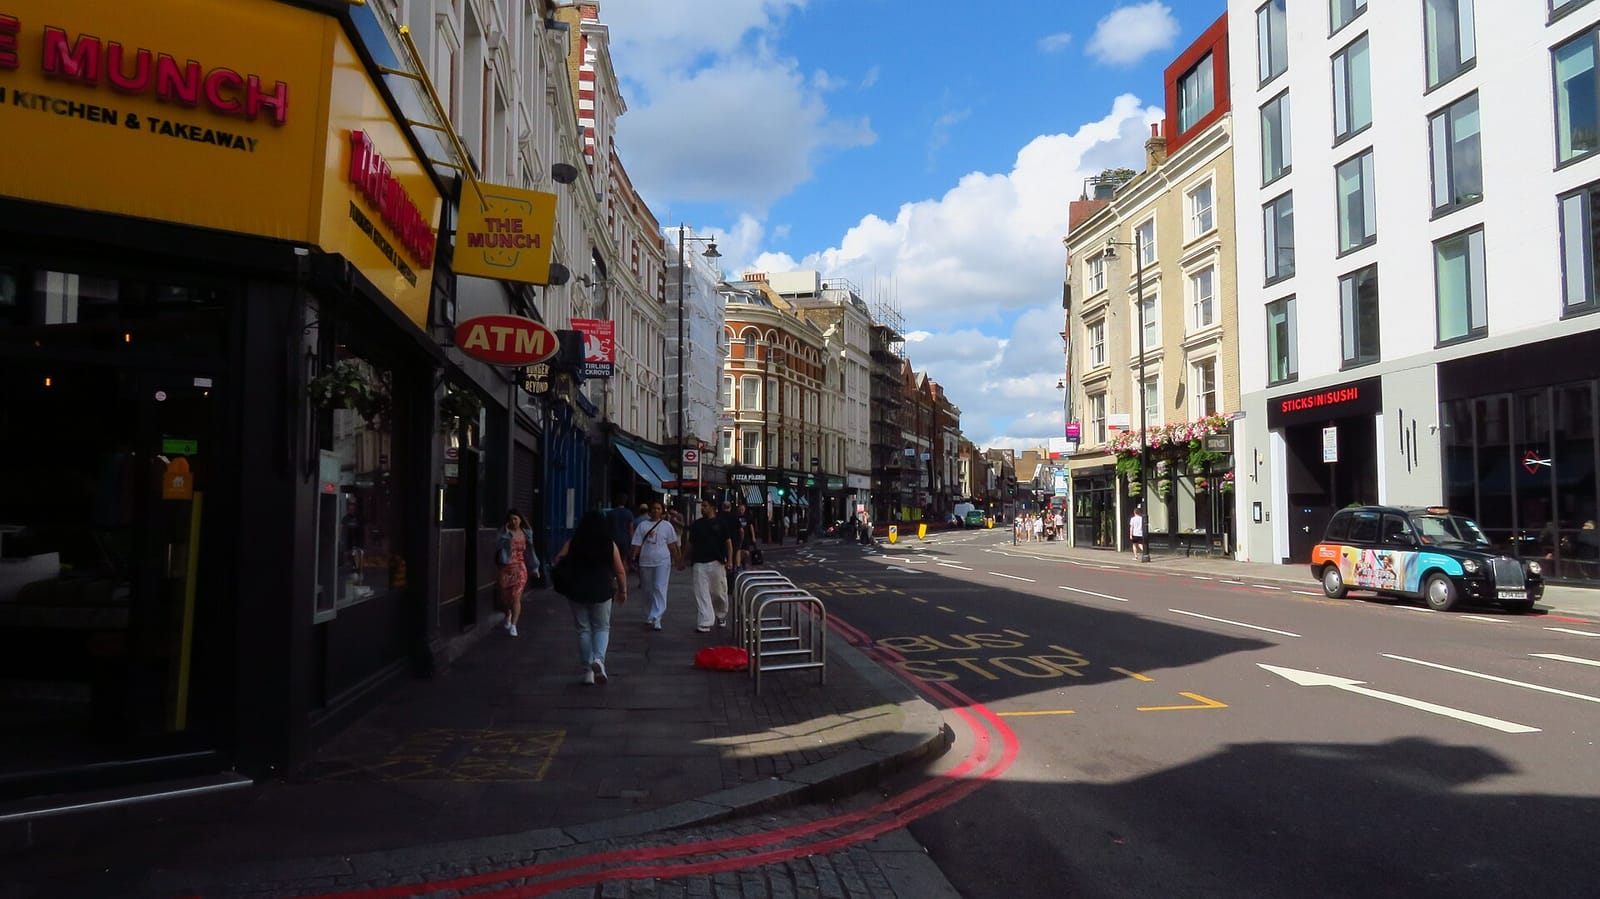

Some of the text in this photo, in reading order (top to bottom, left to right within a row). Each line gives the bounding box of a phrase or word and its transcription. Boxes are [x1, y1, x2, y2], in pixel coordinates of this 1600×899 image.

[43, 25, 289, 127] MUNCH
[13, 88, 118, 126] KITCHEN
[124, 112, 141, 131] &
[147, 116, 259, 153] TAKEAWAY
[485, 218, 523, 233] THE
[467, 233, 541, 249] MUNCH
[463, 324, 546, 355] ATM
[876, 633, 1024, 653] BUS
[897, 655, 1091, 682] STOP
